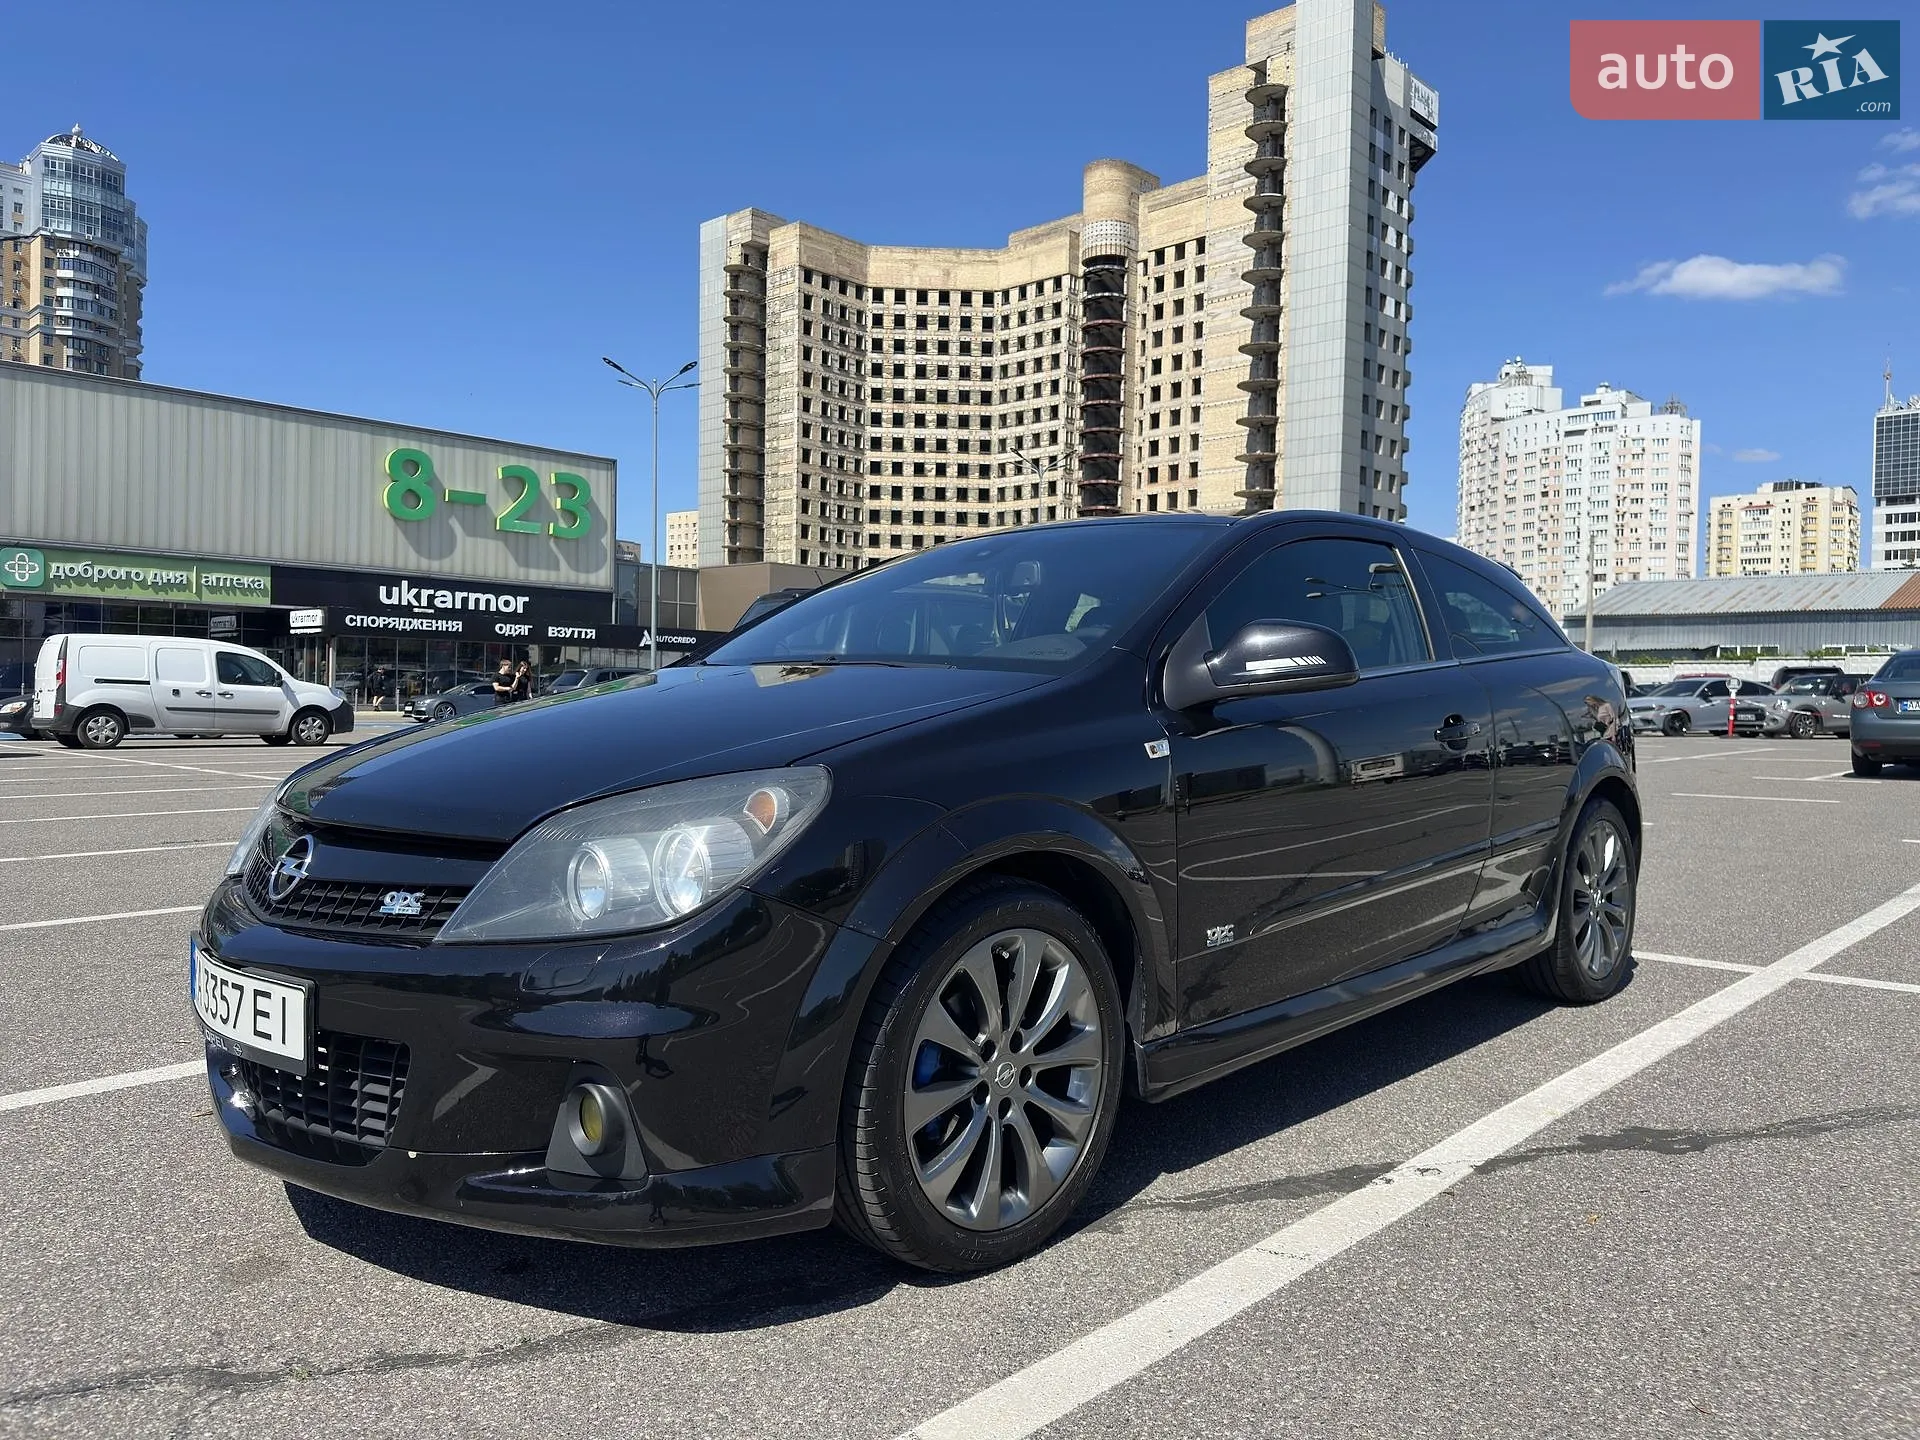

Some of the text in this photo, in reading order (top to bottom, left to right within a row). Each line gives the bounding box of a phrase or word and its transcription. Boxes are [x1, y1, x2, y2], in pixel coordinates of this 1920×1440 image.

[50, 561, 265, 590] доброго дня аптека
[379, 580, 529, 614] ukrarmor
[345, 615, 596, 640] СПОРЯДЖЕННЯ ОДЯГ ВЗУТТЯ
[254, 989, 286, 1045] EI
